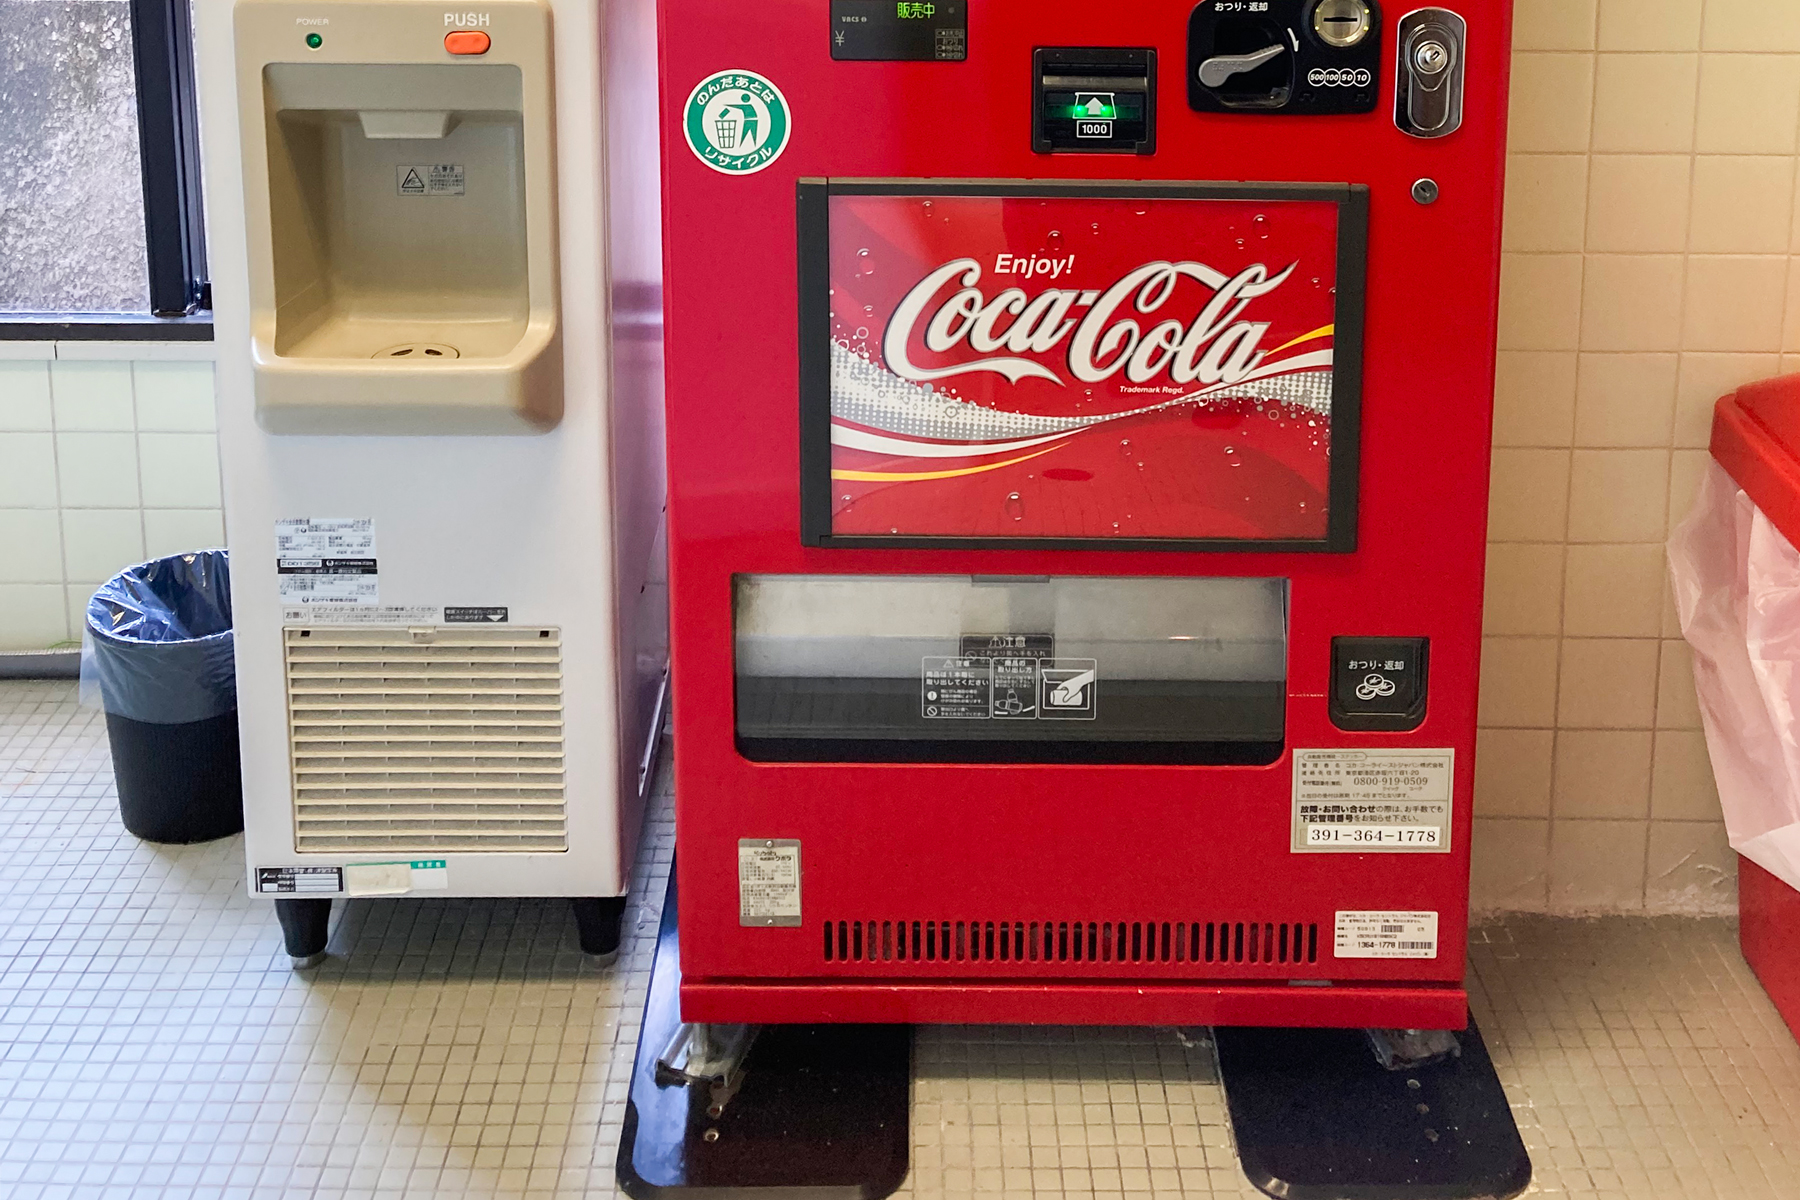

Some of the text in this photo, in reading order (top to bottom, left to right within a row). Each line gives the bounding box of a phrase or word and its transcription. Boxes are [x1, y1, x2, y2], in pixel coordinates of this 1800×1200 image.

[897, 2, 935, 19] 販売中
[296, 18, 329, 26] POWER
[444, 13, 490, 27] PUSH
[1341, 73, 1353, 81] 50
[1356, 73, 1368, 81] 10
[696, 76, 775, 105] のんだあとは
[1082, 124, 1107, 134] 1000
[704, 146, 771, 168] リサイクル
[994, 254, 1074, 278] Enjoy!
[882, 257, 1299, 387] Coca-Cola
[1120, 385, 1162, 394] Trademark
[1354, 777, 1428, 785] 0800-919-0509
[1312, 830, 1436, 842] 391-364-1778
